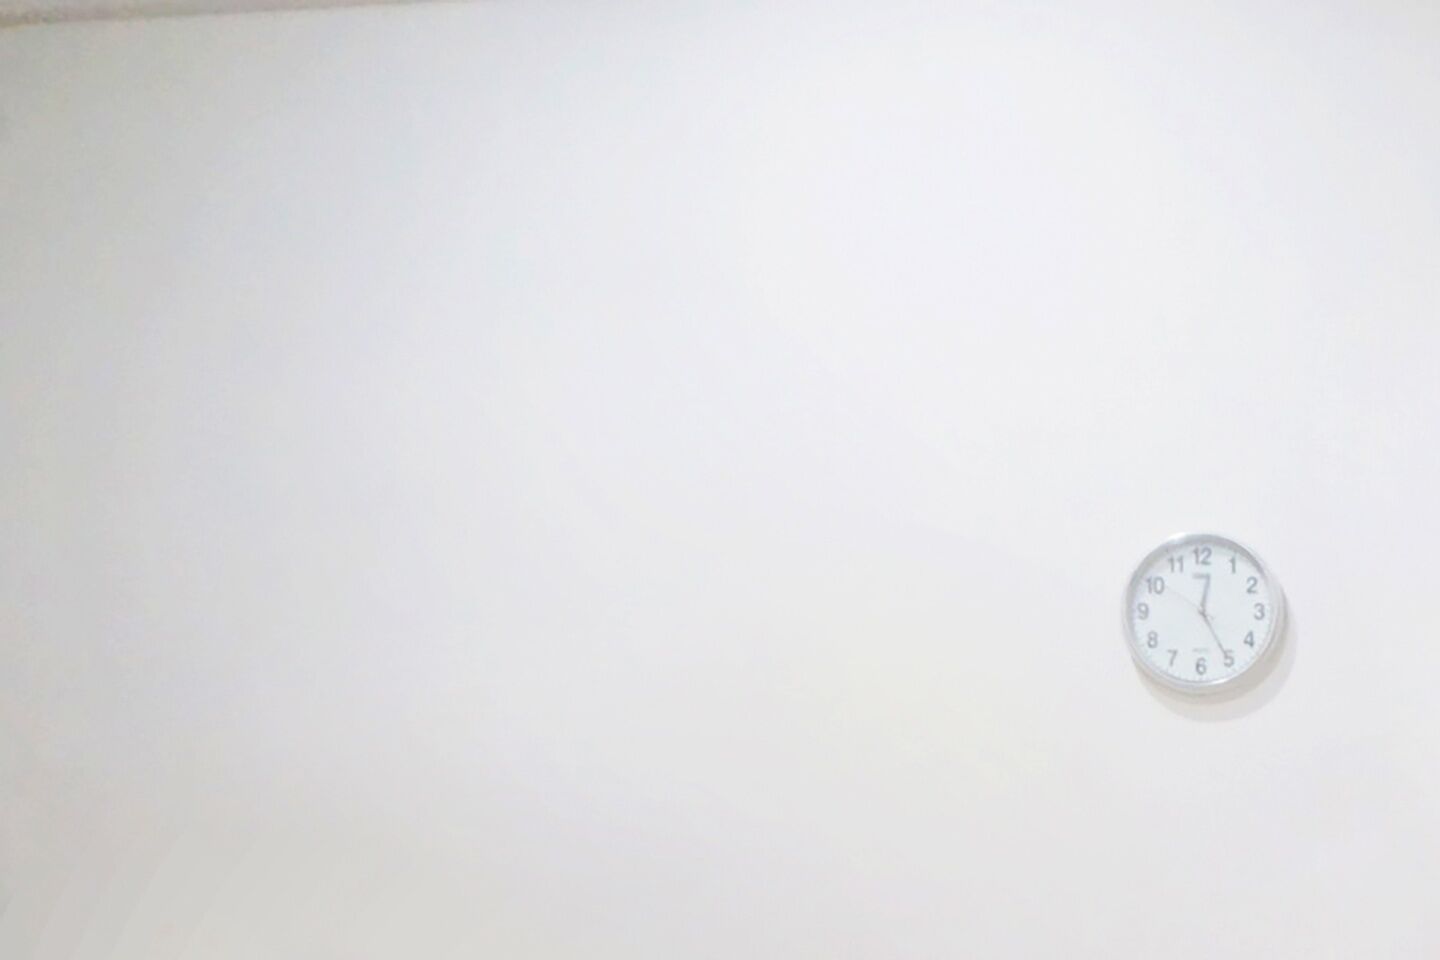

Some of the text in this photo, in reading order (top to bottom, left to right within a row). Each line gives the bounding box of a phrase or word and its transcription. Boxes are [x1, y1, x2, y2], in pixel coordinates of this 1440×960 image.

[1168, 555, 1184, 573] 11
[1192, 547, 1212, 565] 12
[1229, 556, 1237, 574] 1
[1146, 576, 1165, 594] 10
[1246, 576, 1258, 594] 2
[1137, 602, 1149, 620] 9
[1254, 602, 1265, 620] 3
[1147, 631, 1158, 648] 8
[1243, 630, 1254, 648] 4
[1168, 649, 1178, 667] 7
[1195, 657, 1206, 675] 6
[1223, 649, 1234, 668] 5
